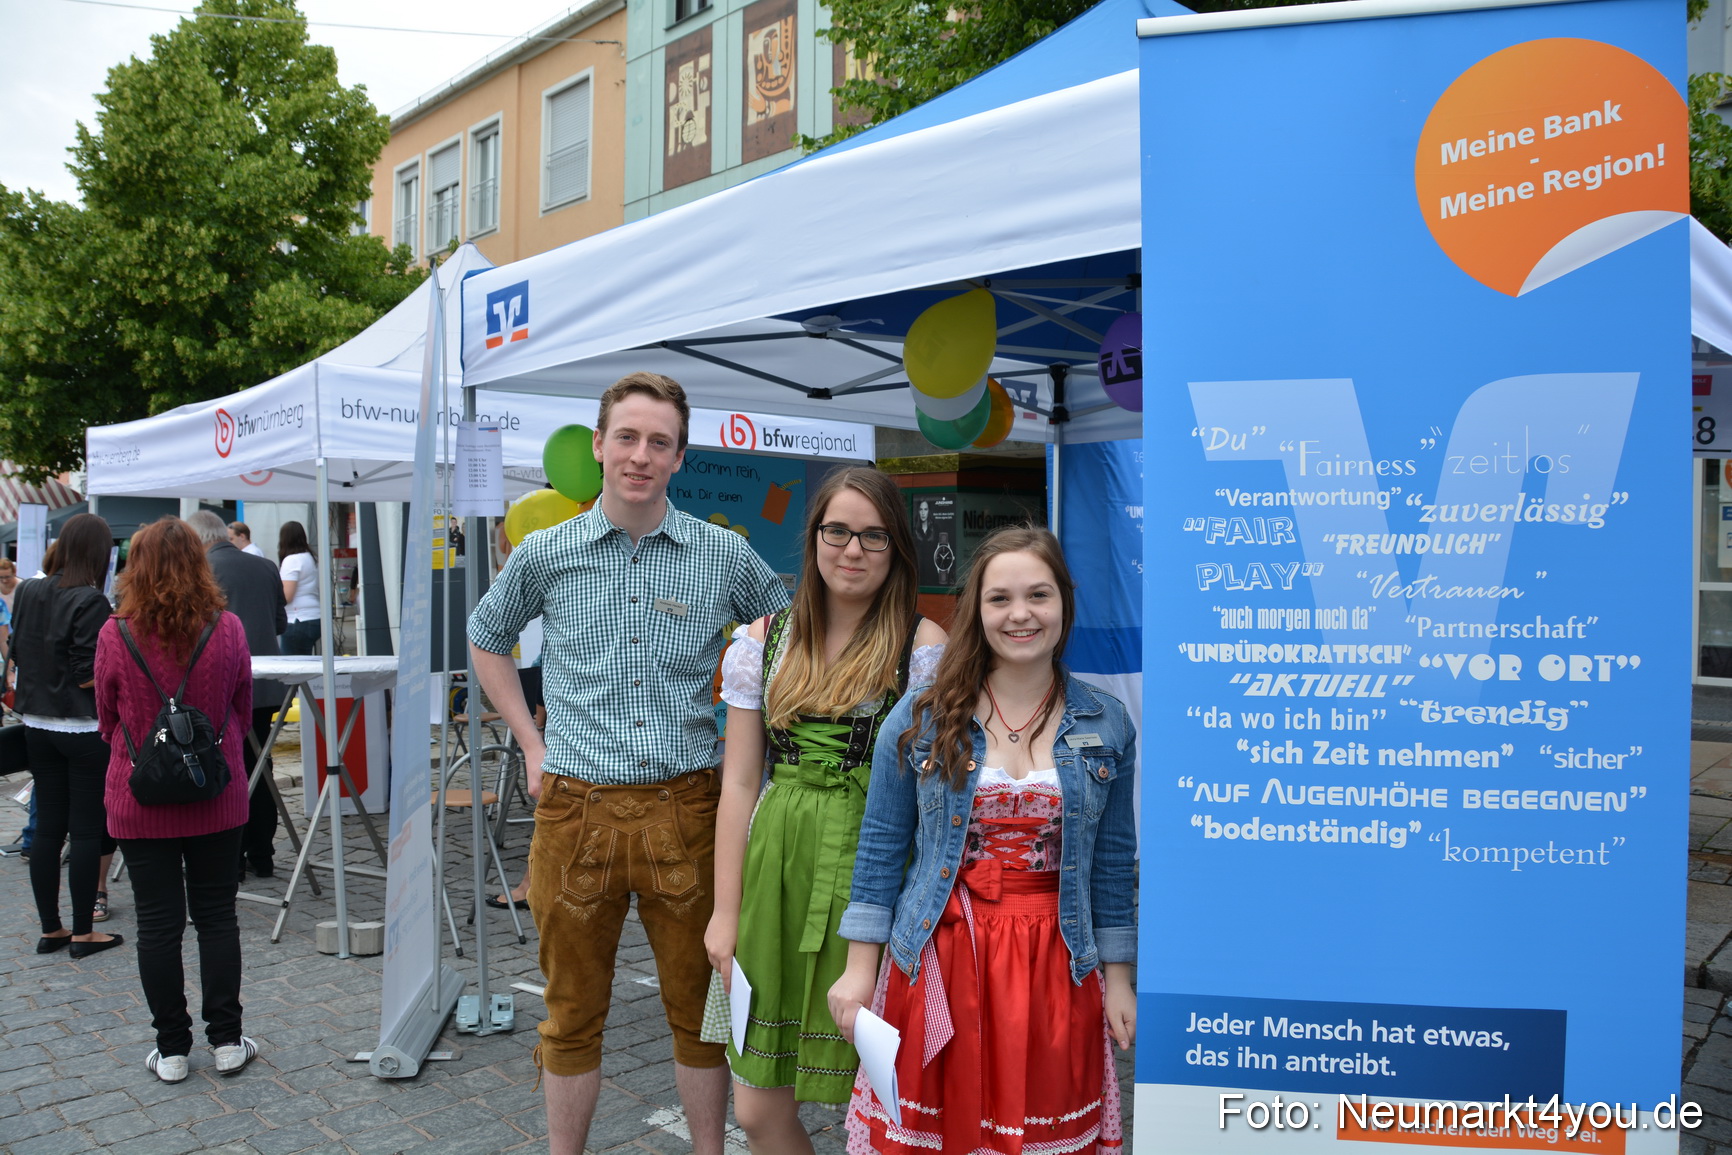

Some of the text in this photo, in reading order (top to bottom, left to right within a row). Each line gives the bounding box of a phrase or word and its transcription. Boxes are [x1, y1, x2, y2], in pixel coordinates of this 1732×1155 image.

[1440, 100, 1622, 166] Meine Bank
[1440, 142, 1665, 220] Meine Region!
[237, 402, 304, 438] bfwnürnberg
[763, 428, 856, 455] bfwregional
[1191, 426, 1266, 450] “Du”
[684, 454, 732, 477] Komm
[1279, 438, 1436, 476] “Fairness”
[698, 488, 713, 500] Dir
[718, 492, 742, 502] einen
[1215, 487, 1629, 529] “Verantwortung” “zuverlässig”
[1322, 533, 1501, 556] “FREUNDLICH”
[1212, 606, 1376, 632] “auch morgen noch da”
[1405, 615, 1598, 638] “Partnerschaft”
[1419, 653, 1522, 681] “VOR
[1538, 654, 1641, 682] ORT”
[1187, 706, 1386, 730] “da wo ich bin”
[1400, 698, 1589, 732] “trendig”
[1236, 738, 1642, 770] “sich Zeit nehmen” “sicher”
[1463, 786, 1647, 812] BEGEGNEN”
[1190, 814, 1626, 872] “bodenständig” “kompetent”
[1186, 1012, 1510, 1051] Jeder Mensch hat etwas,
[1185, 1044, 1397, 1076] das ihn antreibt.
